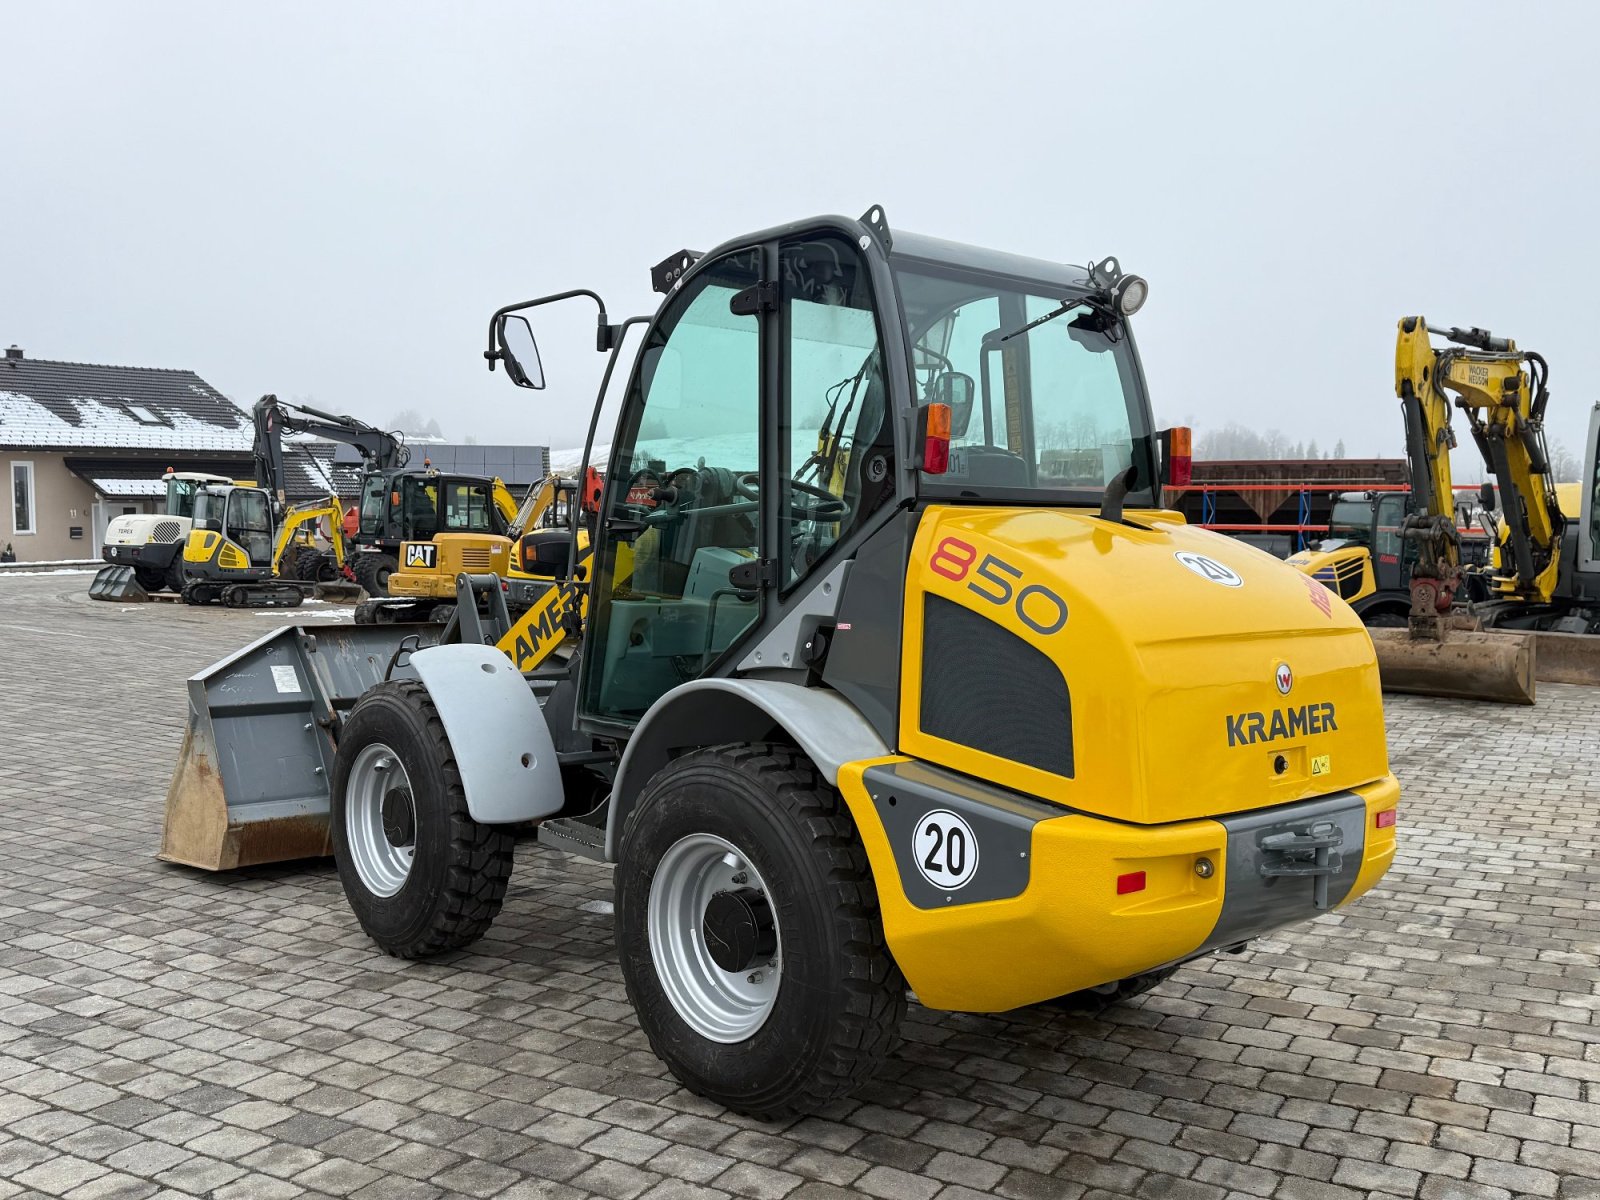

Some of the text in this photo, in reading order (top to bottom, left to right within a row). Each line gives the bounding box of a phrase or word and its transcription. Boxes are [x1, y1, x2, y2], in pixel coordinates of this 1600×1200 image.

[1469, 364, 1489, 377] WACKER
[1469, 375, 1489, 387] NEUSON
[407, 545, 434, 567] CAT
[1182, 556, 1234, 579] 20
[929, 535, 1068, 636] 850
[503, 583, 578, 669] AMER
[1225, 702, 1338, 748] KRAMER
[924, 822, 966, 877] 20
